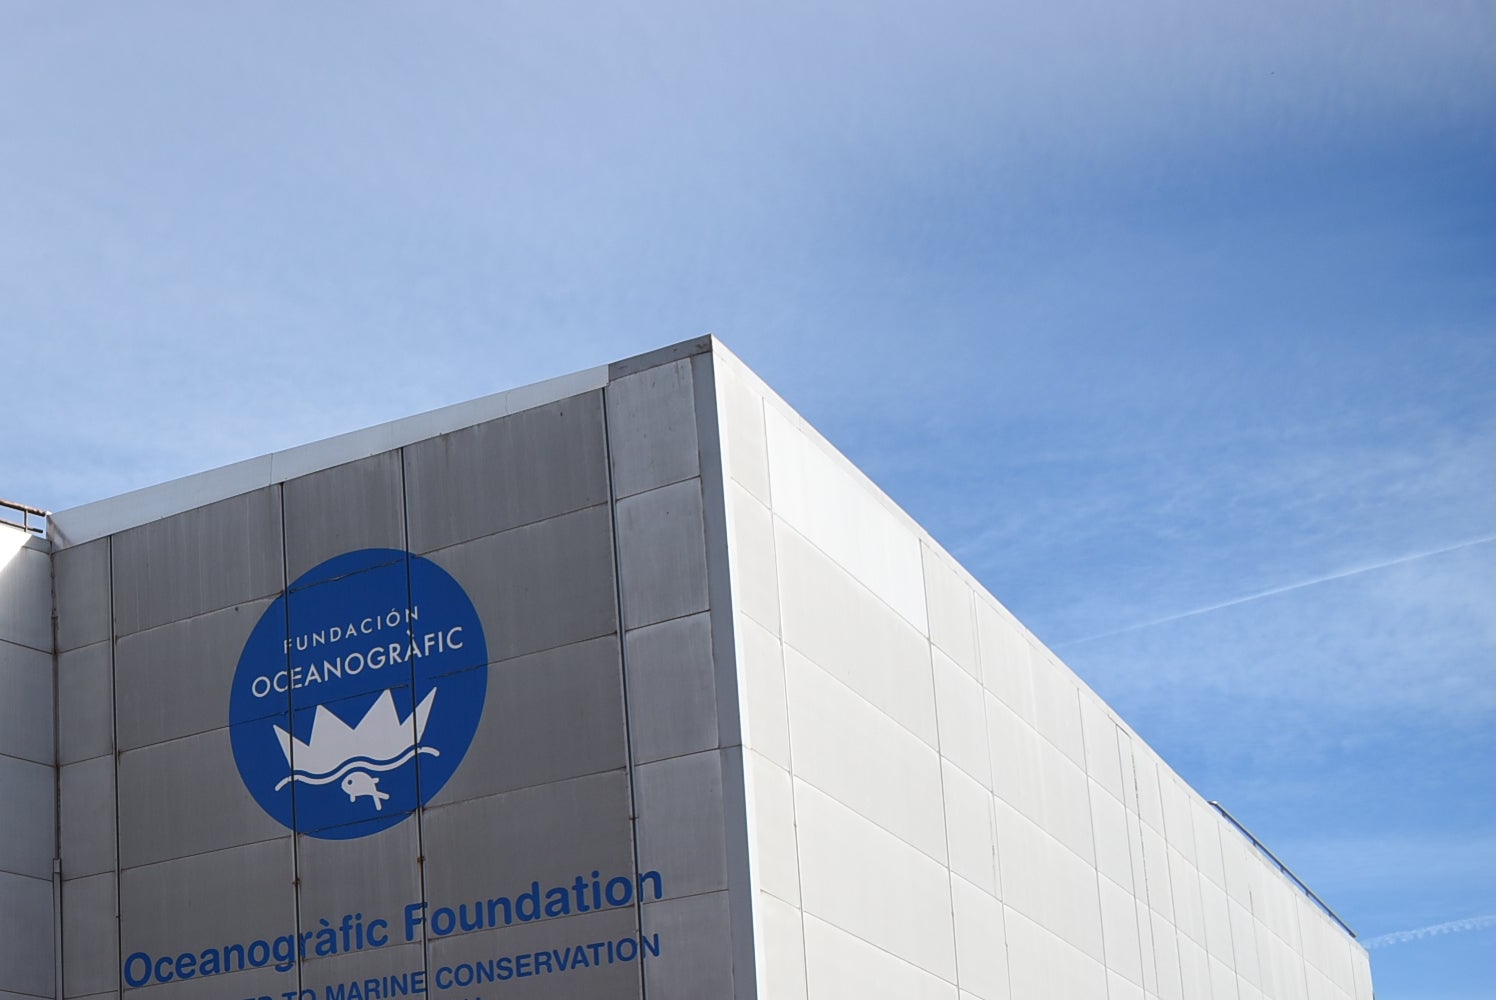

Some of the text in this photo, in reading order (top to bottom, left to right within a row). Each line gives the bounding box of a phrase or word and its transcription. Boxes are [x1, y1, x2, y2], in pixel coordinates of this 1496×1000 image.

[251, 626, 464, 698] OCEANOGRÀFIC
[283, 605, 419, 654] FUNDACIÓN
[123, 868, 664, 989] Oceanogràfic Foundation
[435, 933, 662, 991] CONSERVATION
